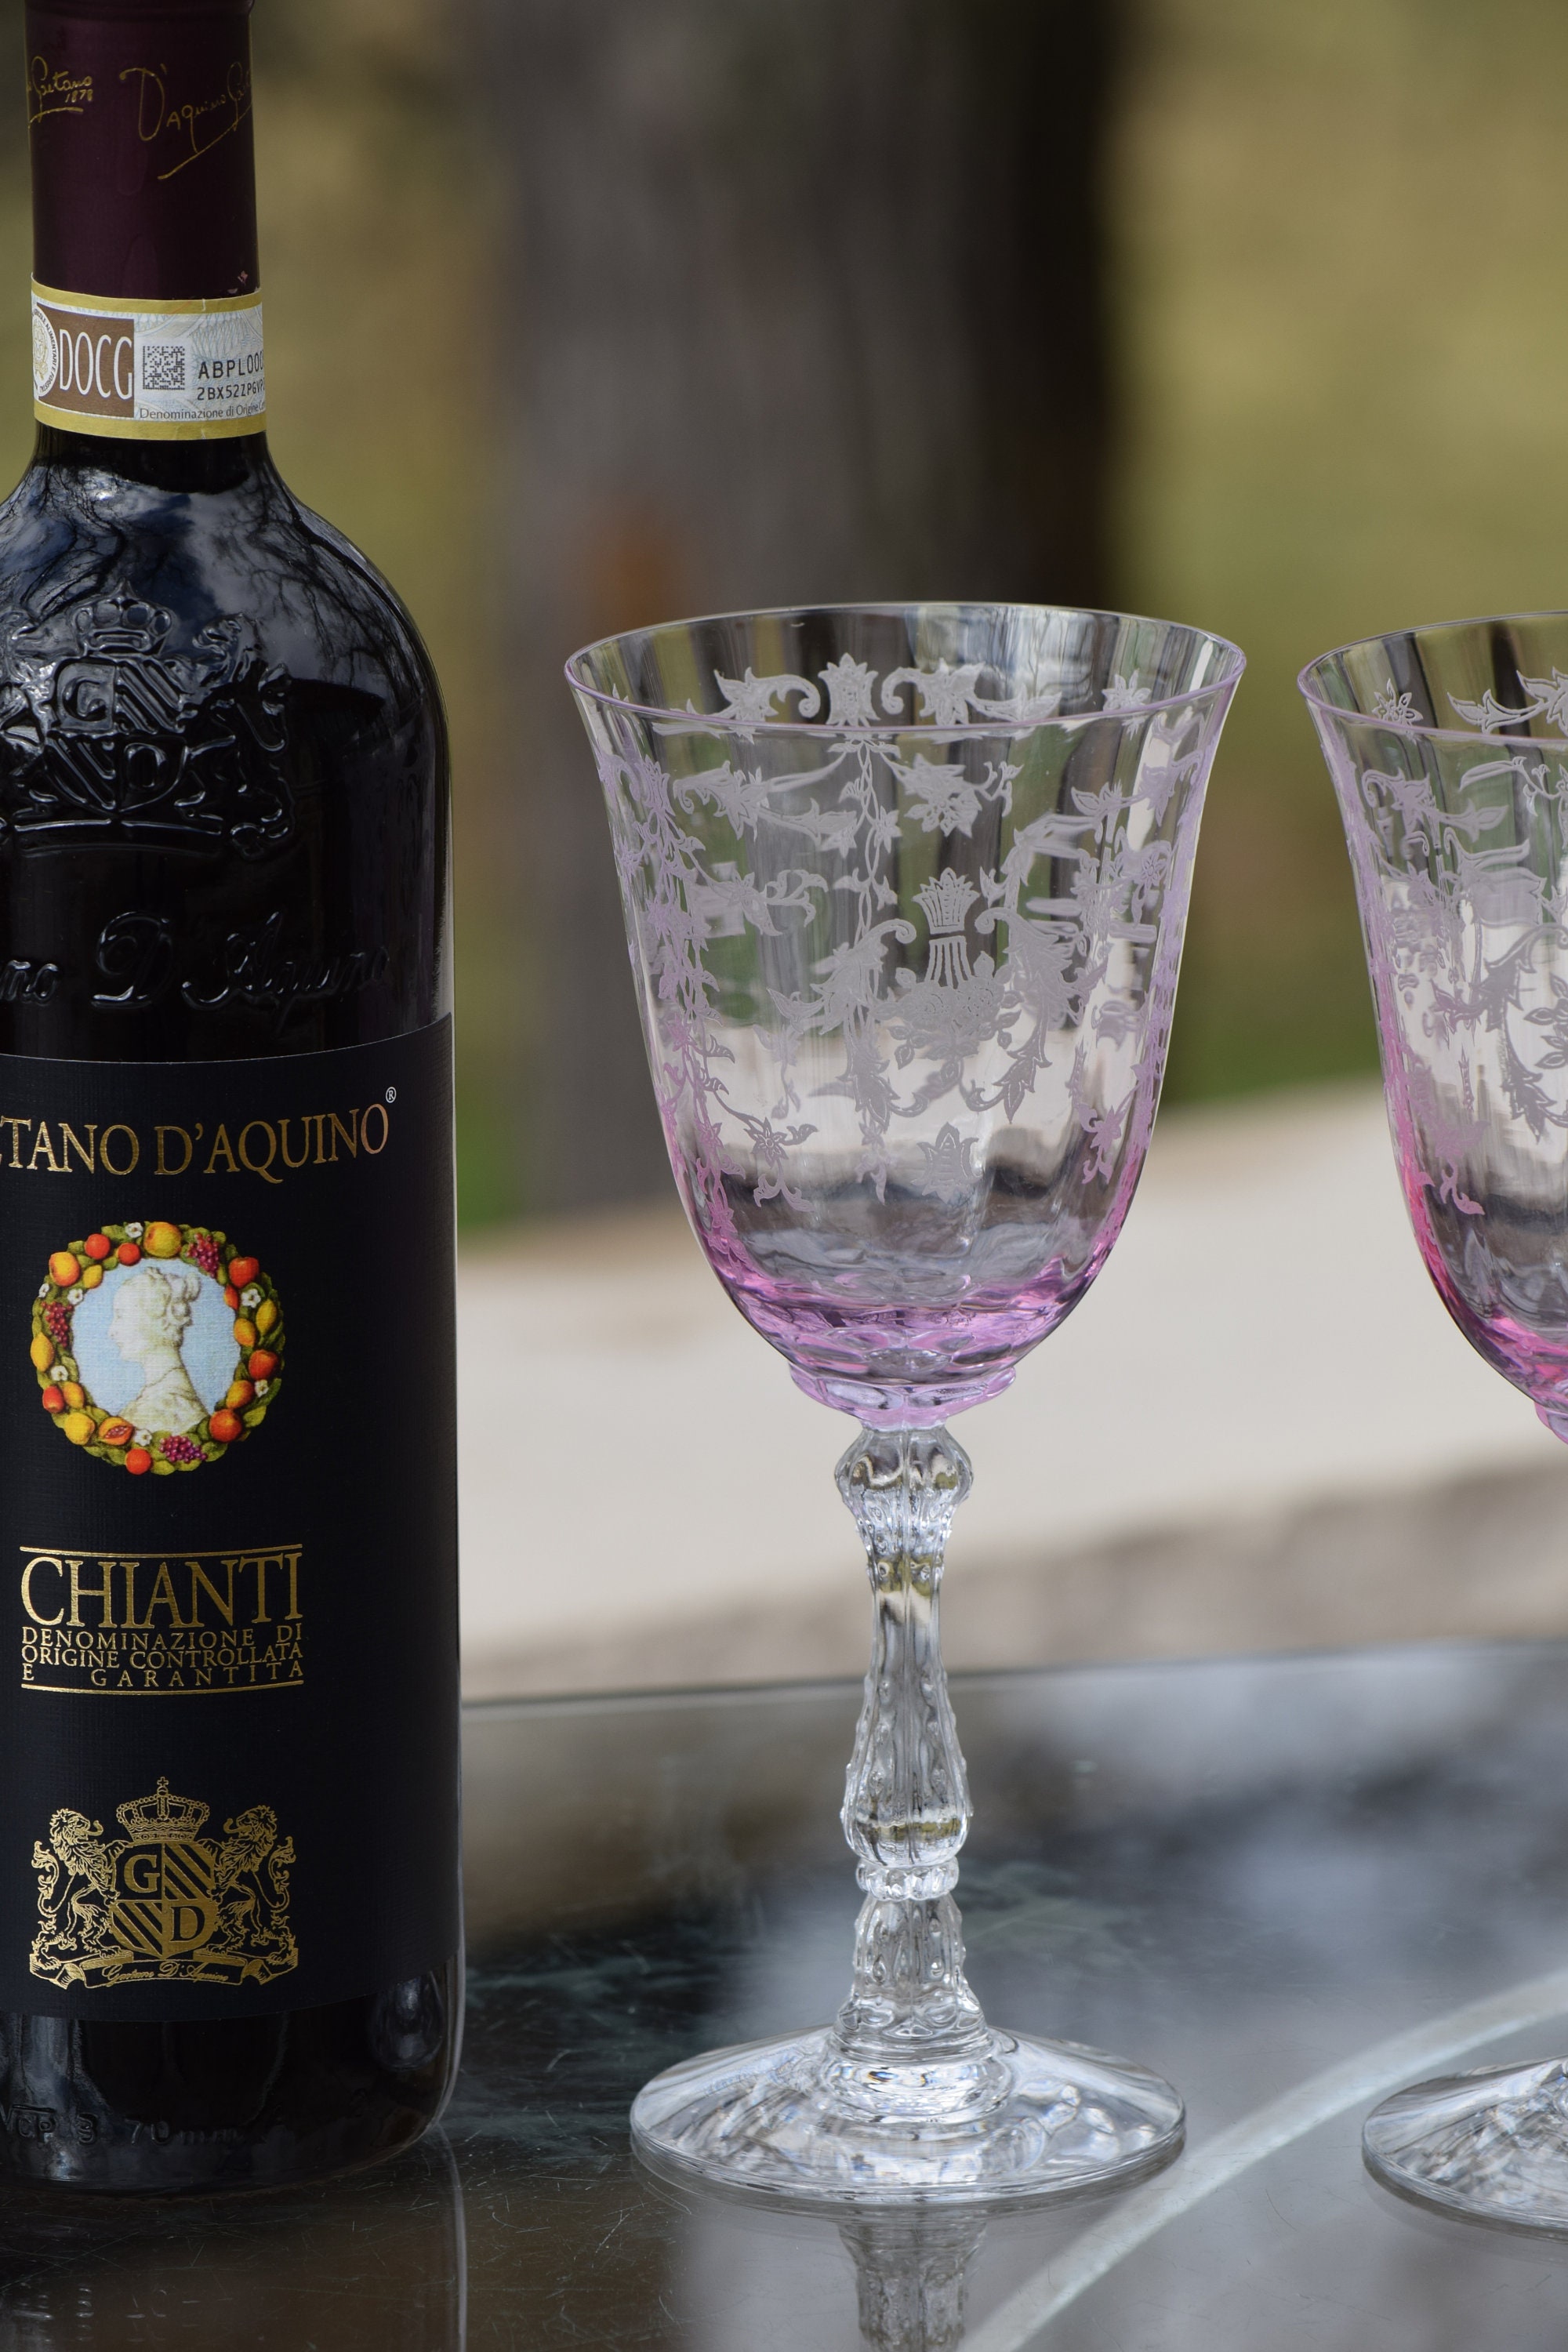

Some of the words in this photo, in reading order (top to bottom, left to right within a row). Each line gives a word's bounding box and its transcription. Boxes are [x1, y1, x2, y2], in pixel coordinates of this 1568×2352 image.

[59, 328, 132, 400] DOCG
[140, 408, 223, 419] Denominazione
[226, 405, 234, 417] di
[236, 403, 259, 417] Origine
[0, 1116, 140, 1175] TANO
[154, 1103, 389, 1184] D'AQUINO
[20, 1552, 303, 1629] CHIANTI
[22, 1625, 255, 1651] DENOMINAZIONE
[277, 1623, 302, 1645] DI
[22, 1644, 120, 1668] ORIGINE
[129, 1642, 303, 1670] CONTROLLATA
[22, 1663, 34, 1682] E
[90, 1661, 304, 1687] GARANTITA
[123, 1854, 160, 1893] G
[170, 1905, 207, 1942] D
